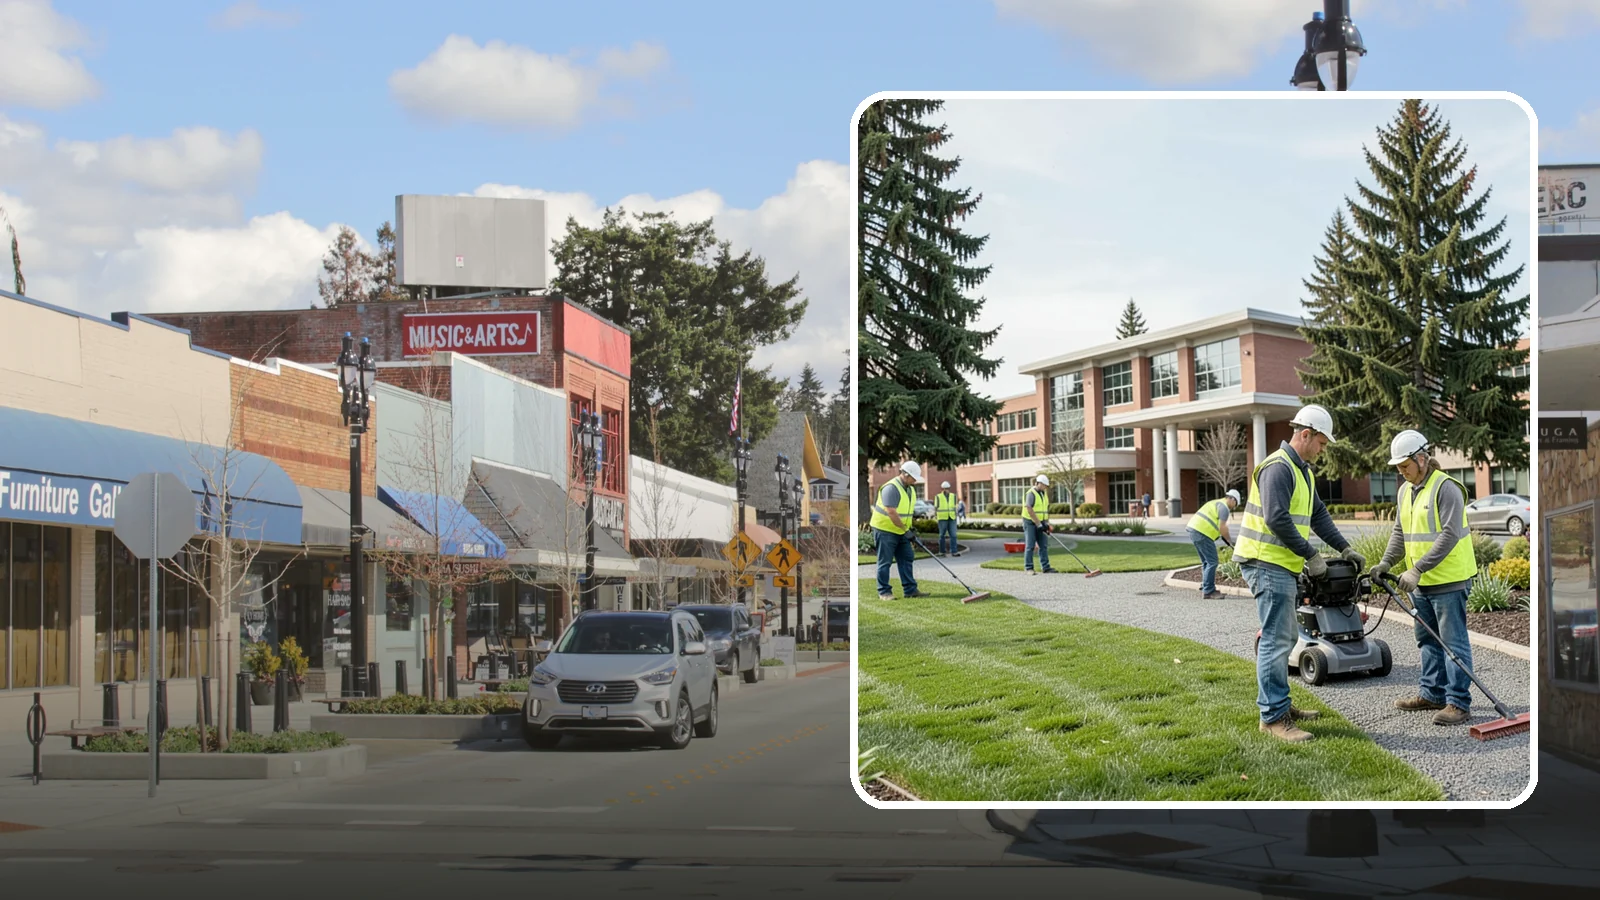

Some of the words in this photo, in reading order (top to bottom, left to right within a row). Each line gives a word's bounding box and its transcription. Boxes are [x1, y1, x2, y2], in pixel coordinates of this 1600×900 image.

[409, 323, 520, 349] MUSIC&ARTS
[1540, 427, 1577, 436] UGA
[0, 472, 79, 515] Furniture
[89, 483, 121, 519] Gal
